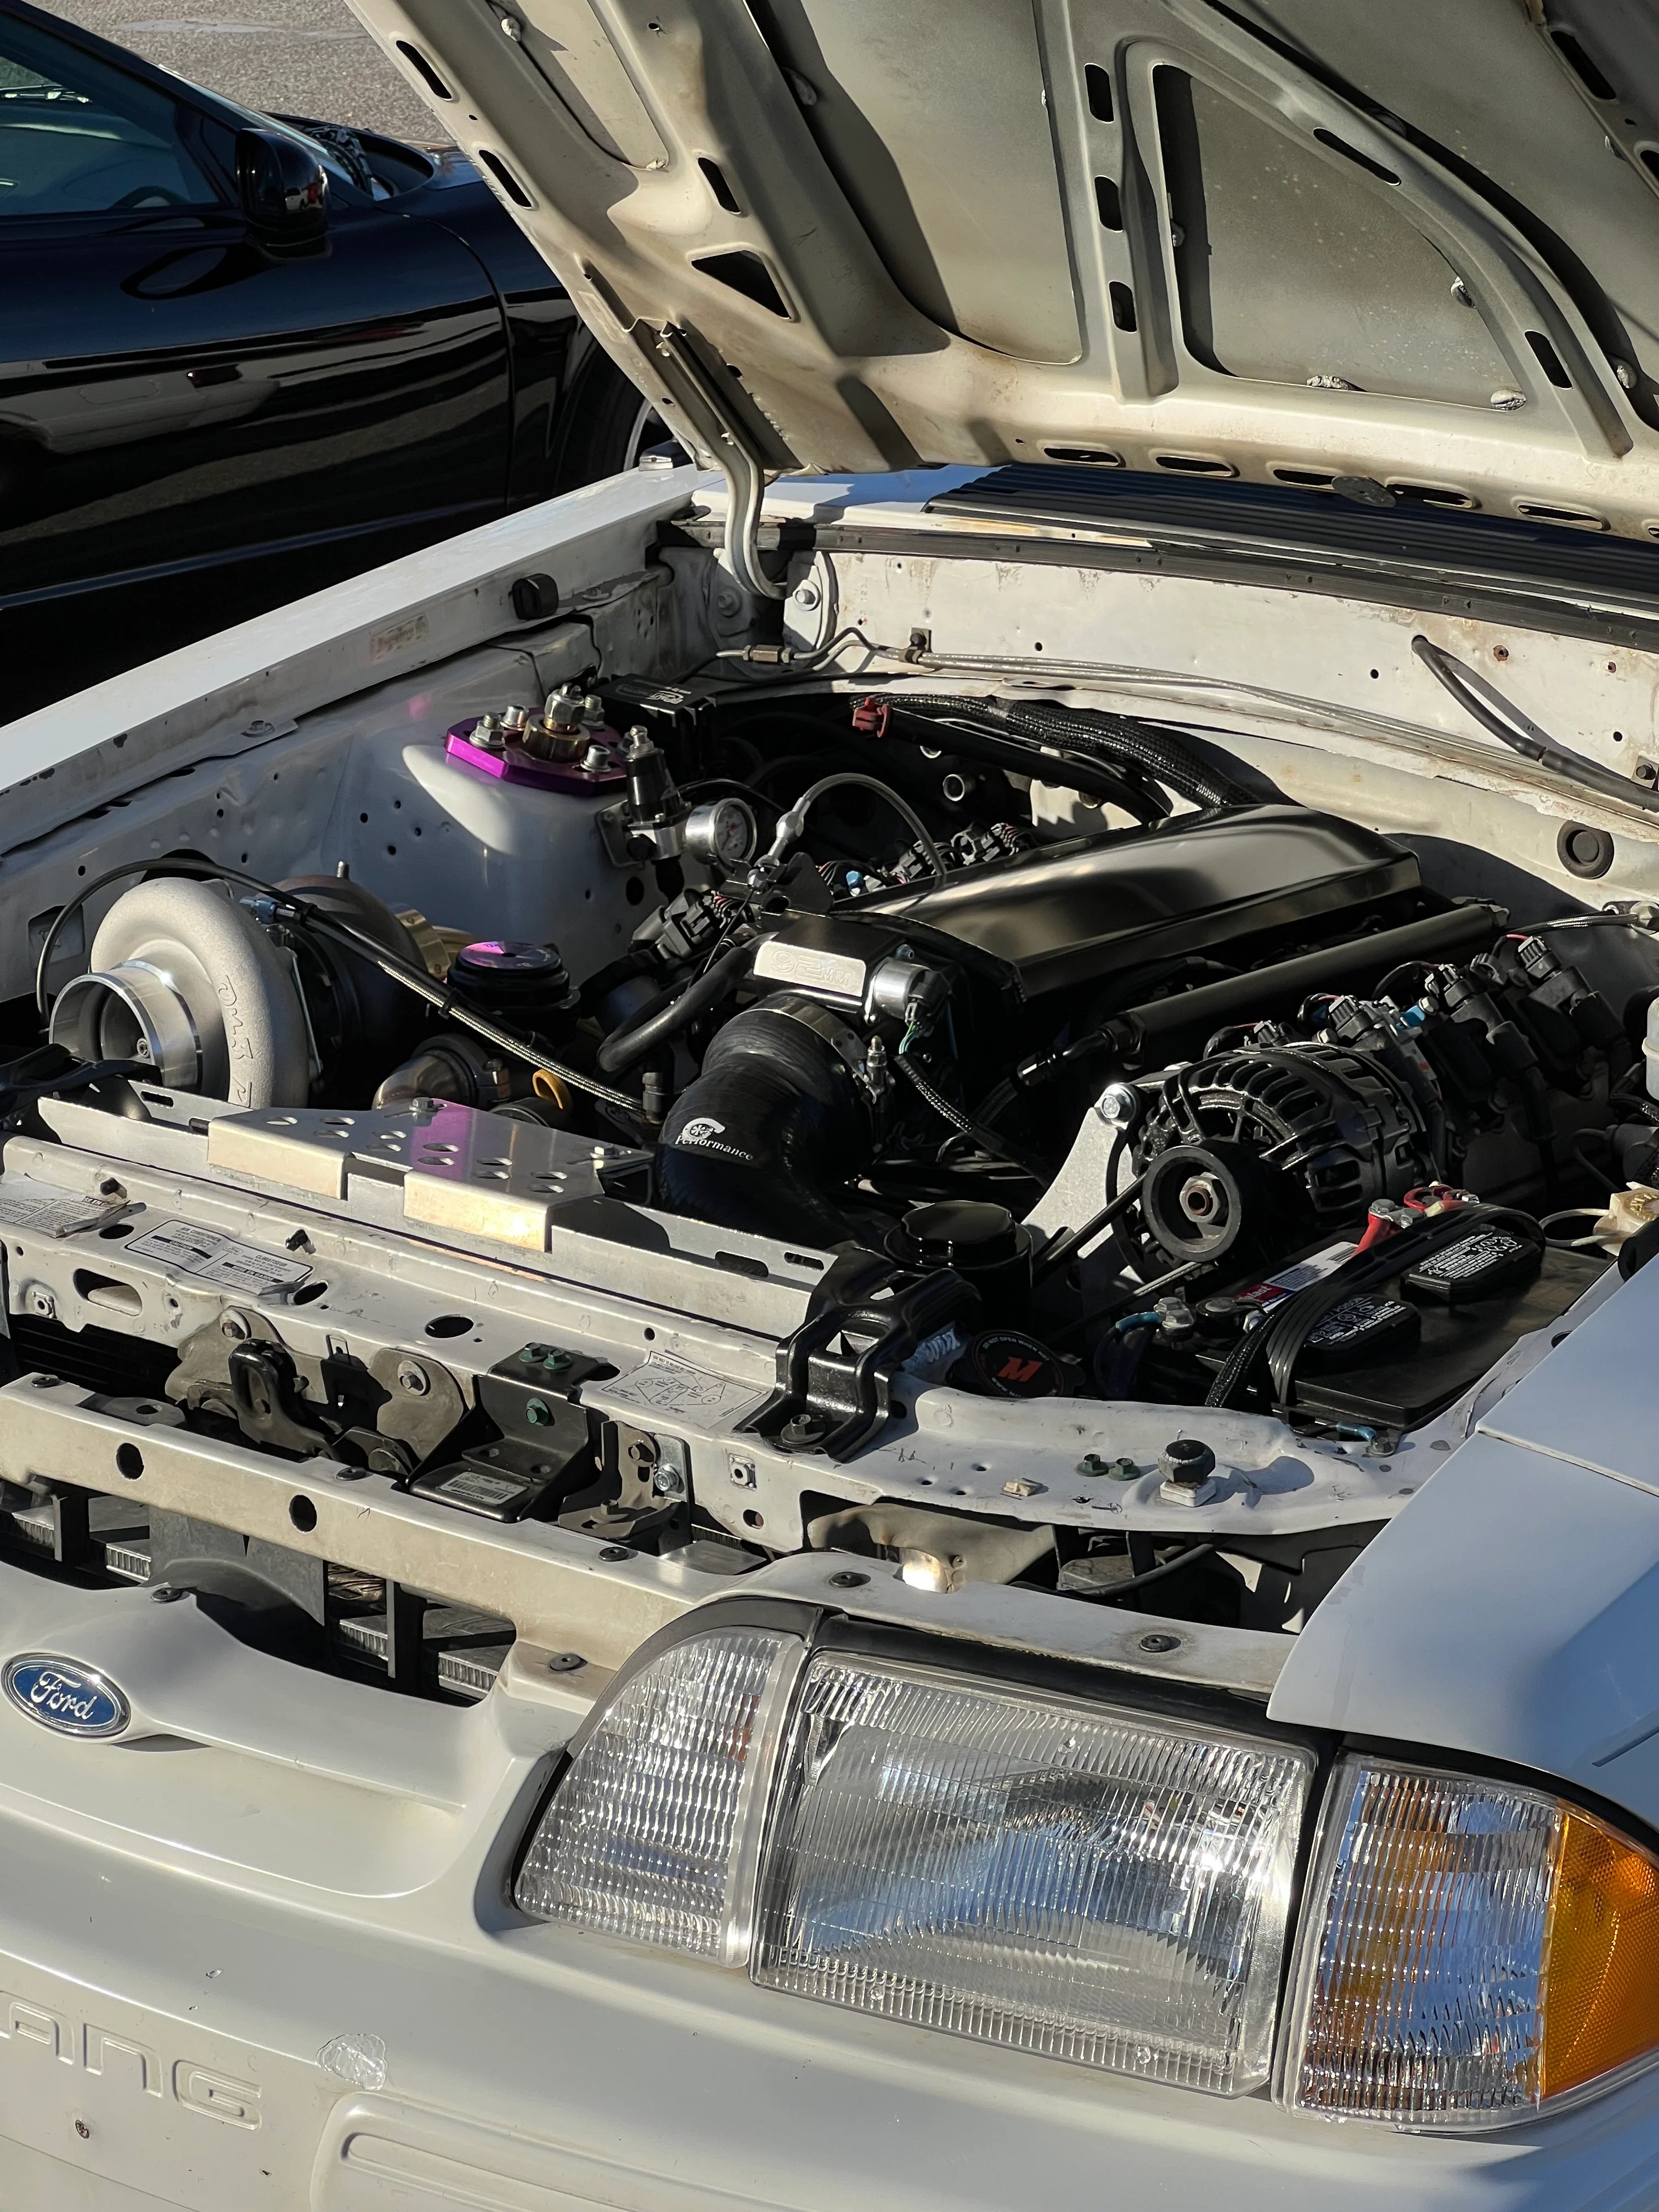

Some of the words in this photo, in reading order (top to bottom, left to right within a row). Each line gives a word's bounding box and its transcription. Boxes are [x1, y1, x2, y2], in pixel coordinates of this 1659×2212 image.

[675, 1133, 754, 1161] Performance
[169, 1240, 194, 1250] CAUTION
[1018, 1339, 1038, 1352] WHEN
[30, 1669, 98, 1722] Ford
